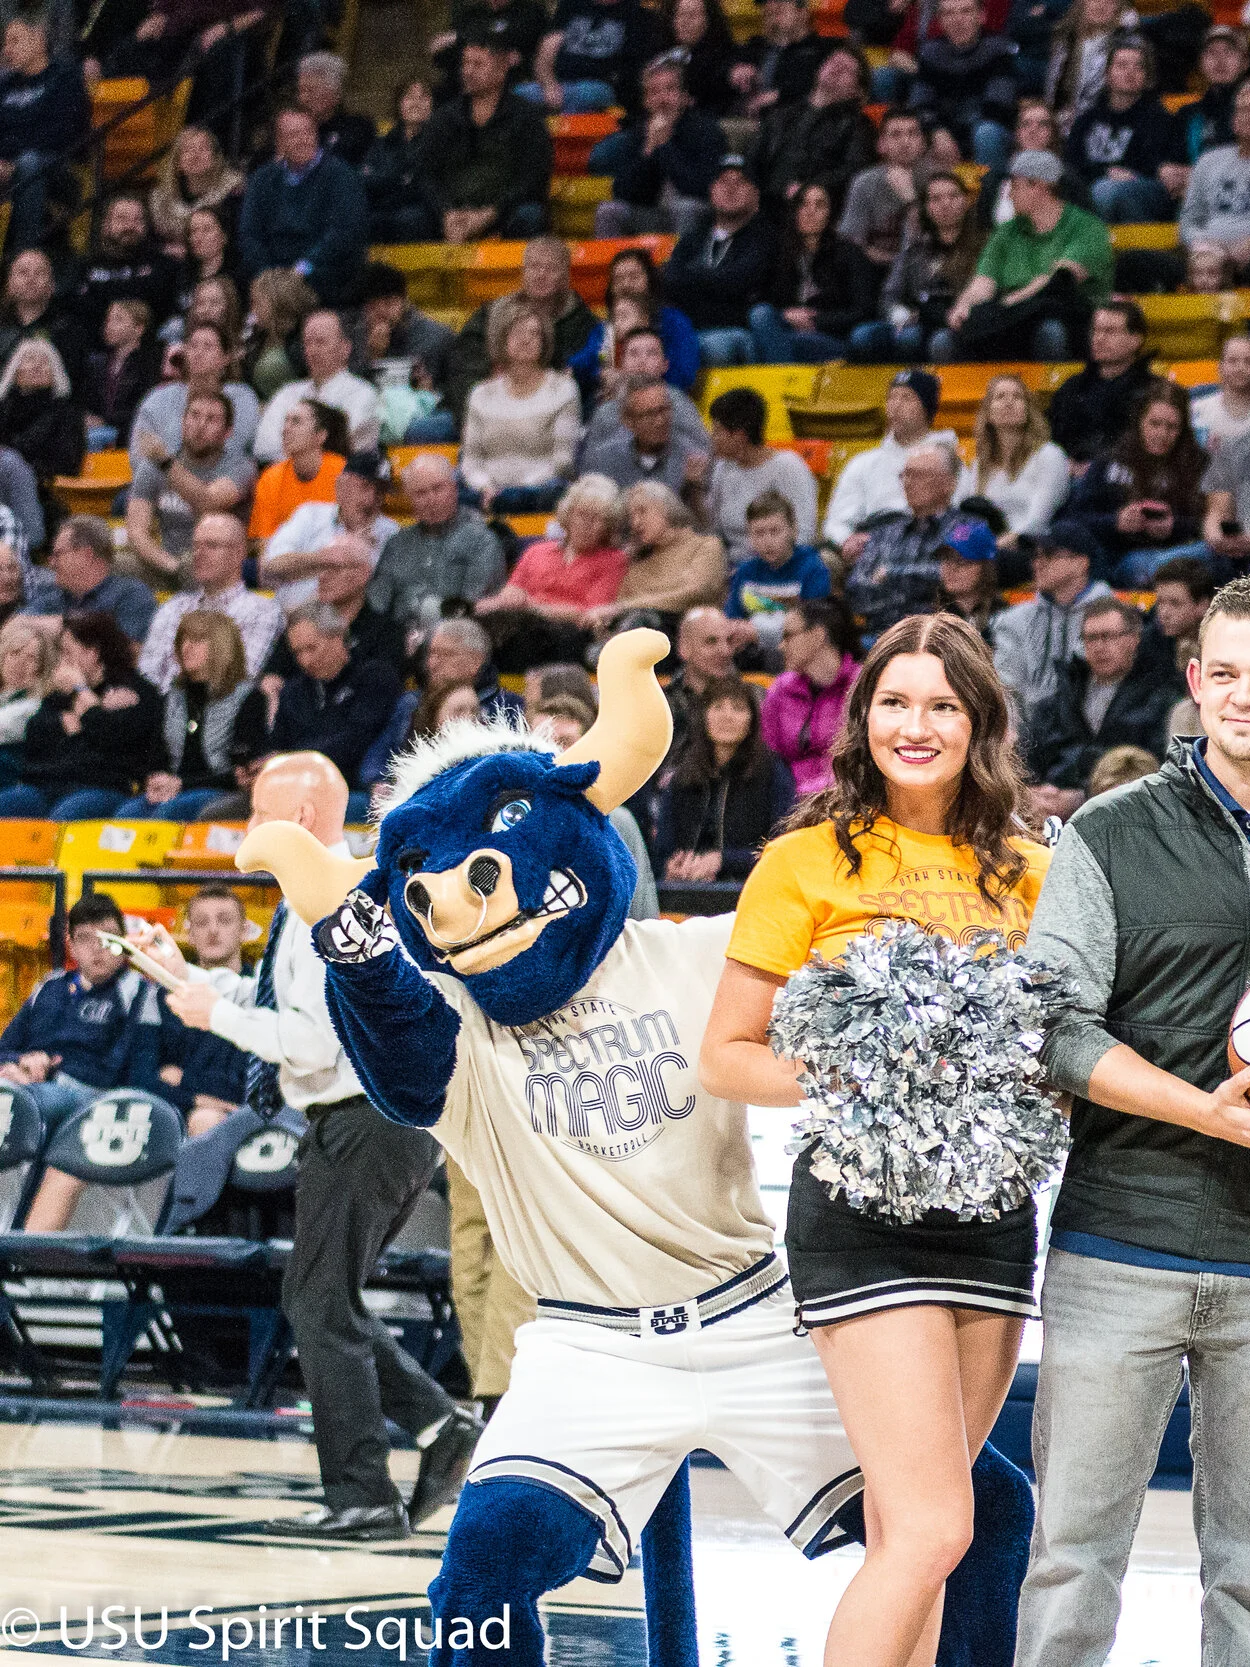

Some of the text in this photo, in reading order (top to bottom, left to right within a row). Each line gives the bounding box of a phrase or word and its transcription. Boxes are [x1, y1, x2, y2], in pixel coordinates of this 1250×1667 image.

[899, 871, 929, 887] UTAH
[571, 1001, 618, 1018] STATE
[518, 1009, 681, 1074] SPECTRUM
[525, 1051, 696, 1137] MAGIC
[578, 1133, 648, 1157] BASKETBALL
